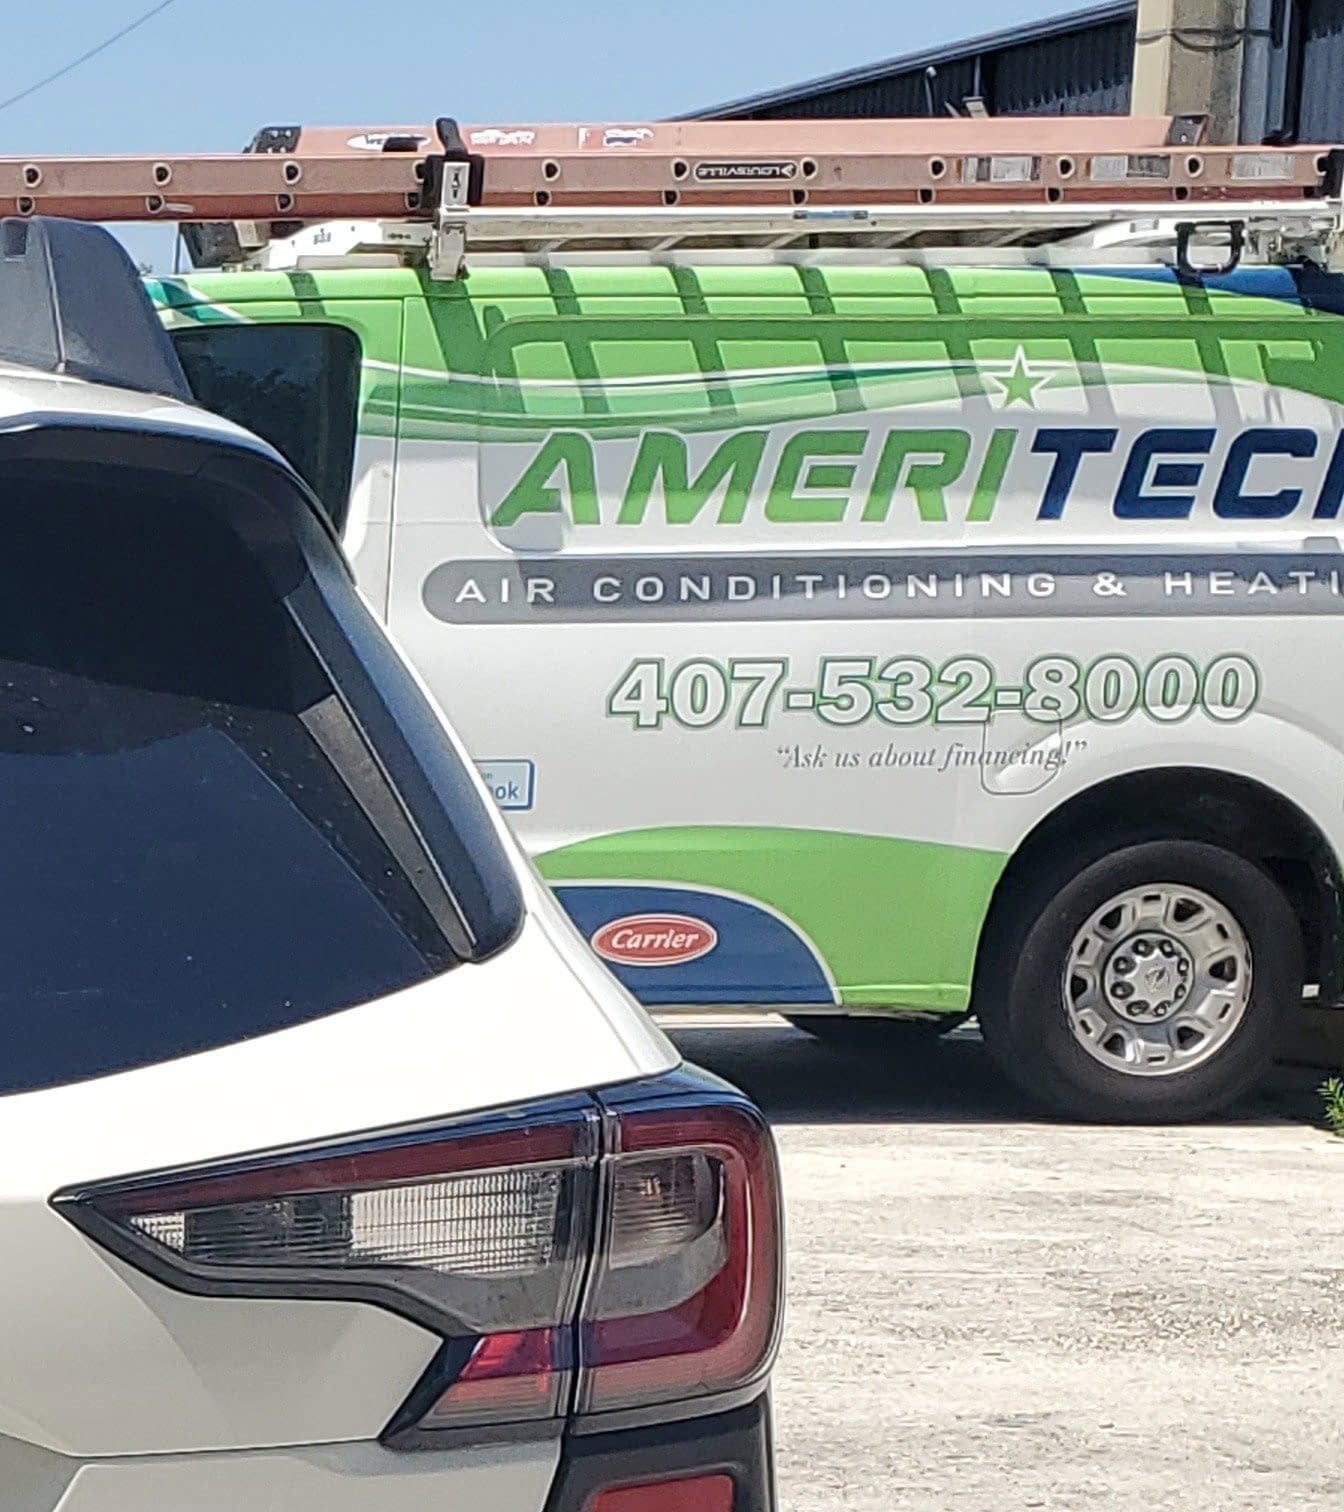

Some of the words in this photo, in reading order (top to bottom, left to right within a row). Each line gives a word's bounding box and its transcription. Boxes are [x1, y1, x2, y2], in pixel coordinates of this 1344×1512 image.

[455, 577, 555, 604] AIR
[593, 572, 1056, 603] CONDITIONING
[1092, 572, 1128, 598] &
[606, 655, 1260, 731] 407-532-8000
[834, 751, 860, 768] us
[868, 743, 936, 768] about
[611, 929, 700, 949] Carrier
